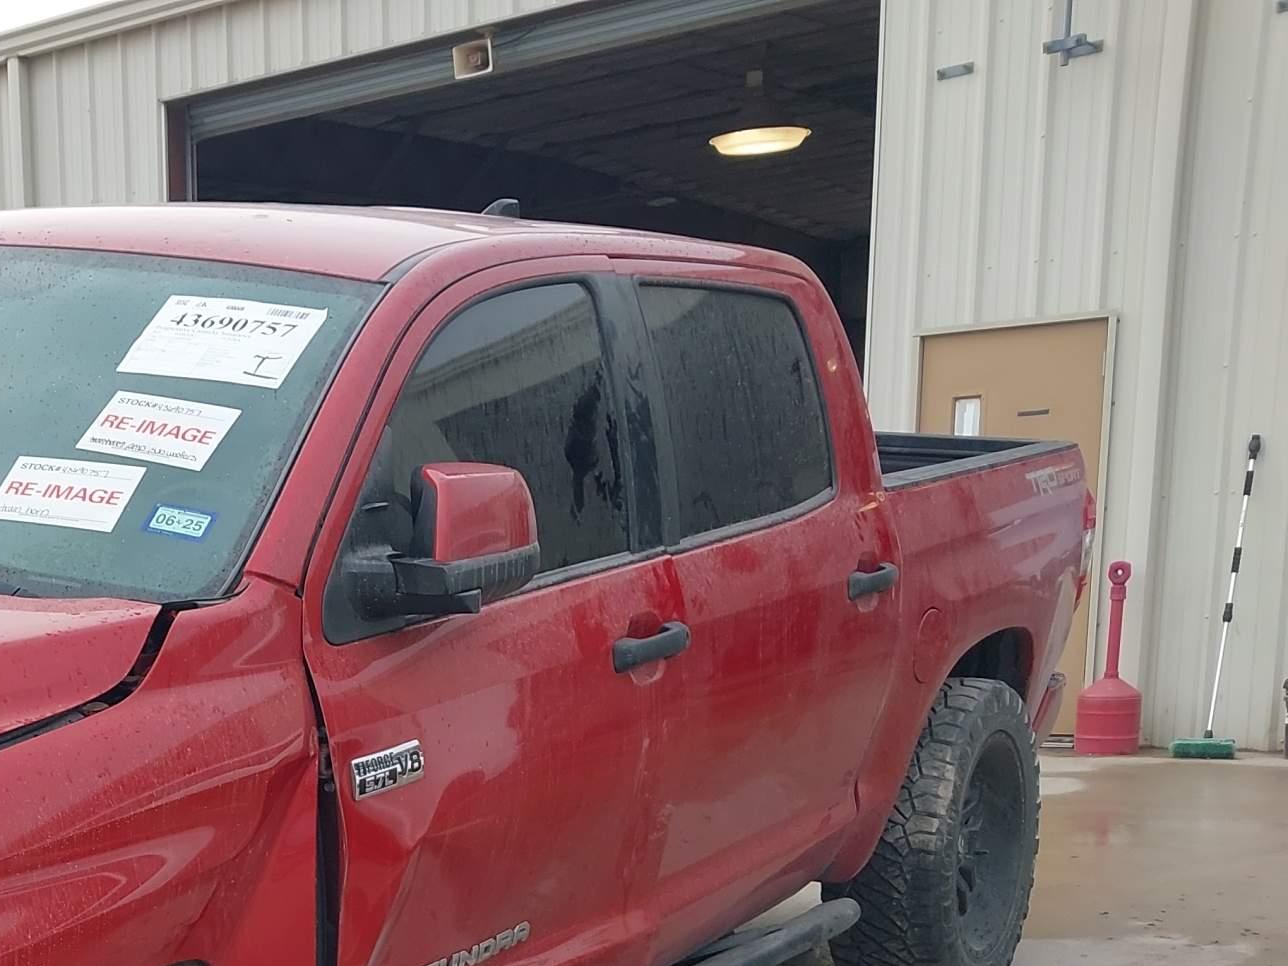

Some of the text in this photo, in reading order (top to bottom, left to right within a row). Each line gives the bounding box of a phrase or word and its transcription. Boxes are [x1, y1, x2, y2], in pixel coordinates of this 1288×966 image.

[170, 312, 300, 338] 43690757
[99, 413, 217, 446] RE-IMAGE
[4, 480, 125, 506] RE-IMAGE
